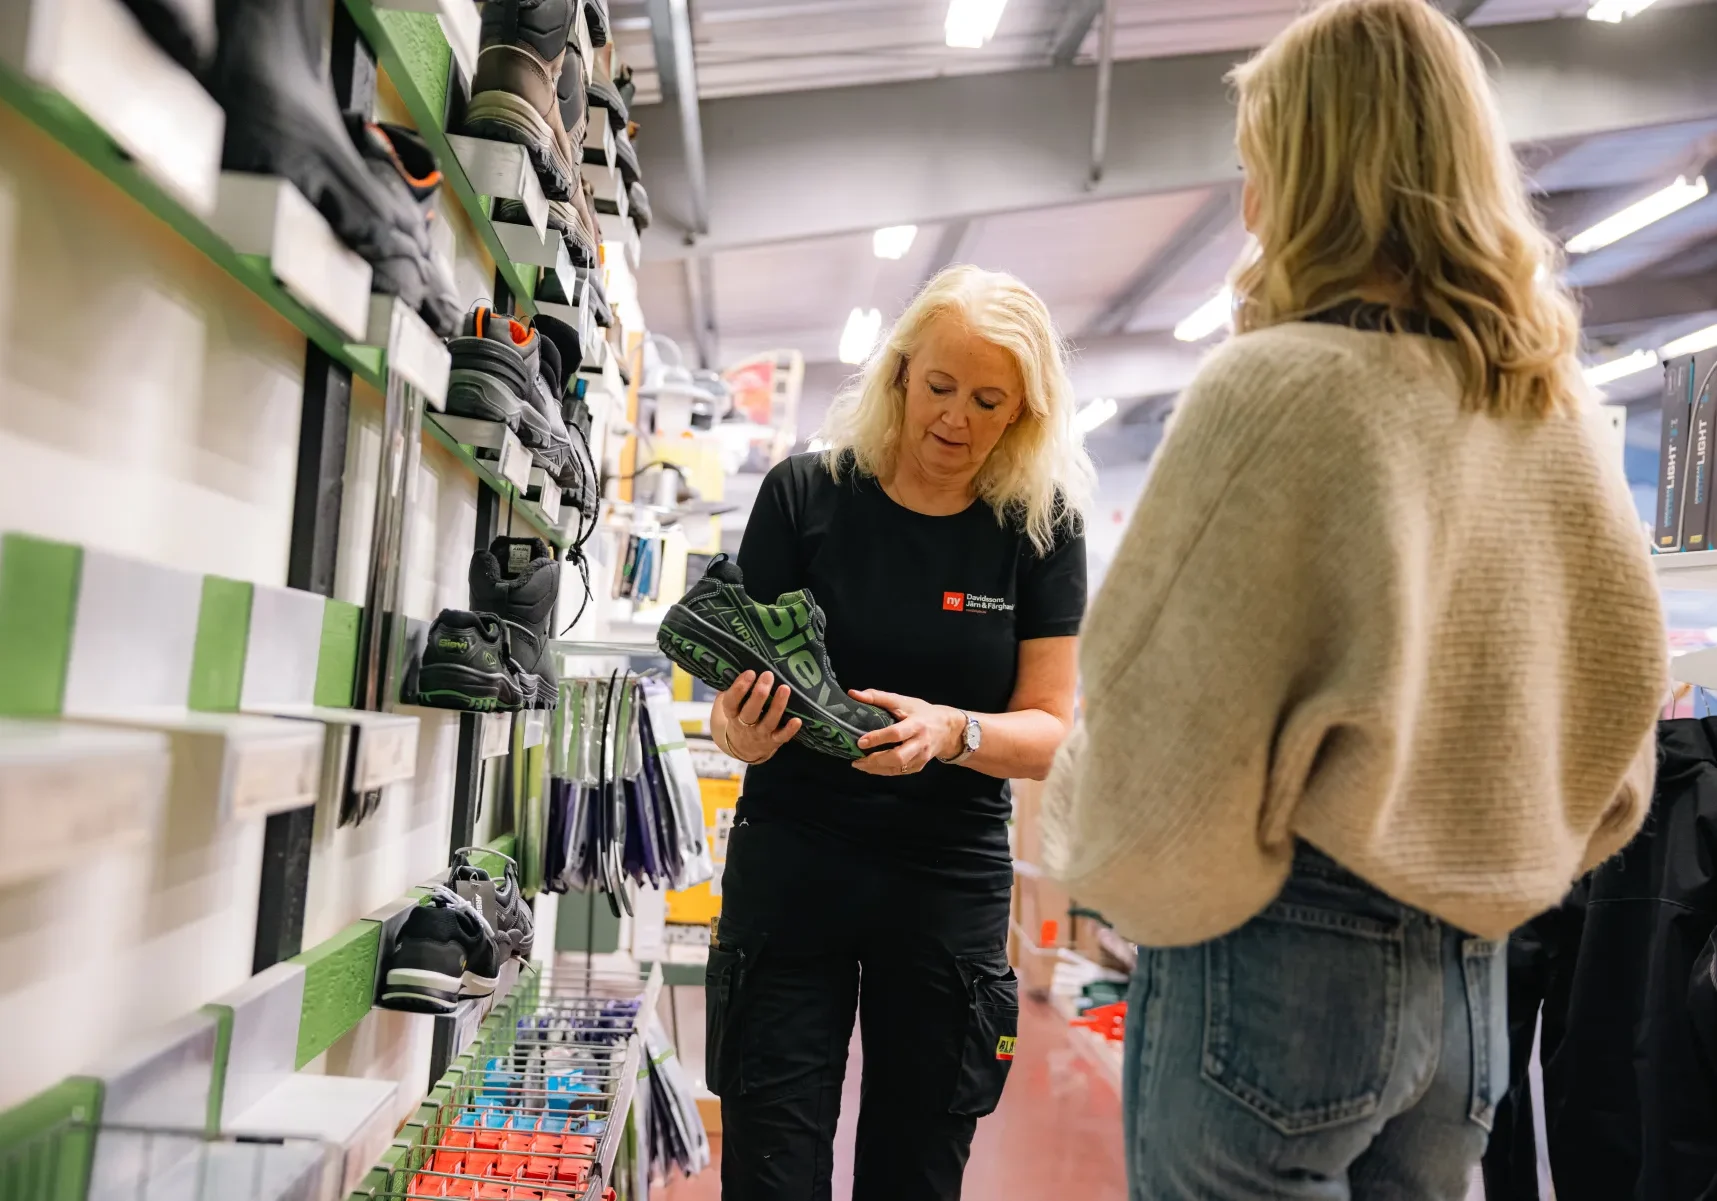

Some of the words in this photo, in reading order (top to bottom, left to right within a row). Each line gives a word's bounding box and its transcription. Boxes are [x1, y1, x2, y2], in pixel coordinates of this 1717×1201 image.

[1666, 444, 1677, 489] LIGHT
[946, 596, 961, 607] ny
[438, 638, 468, 650] Sievi
